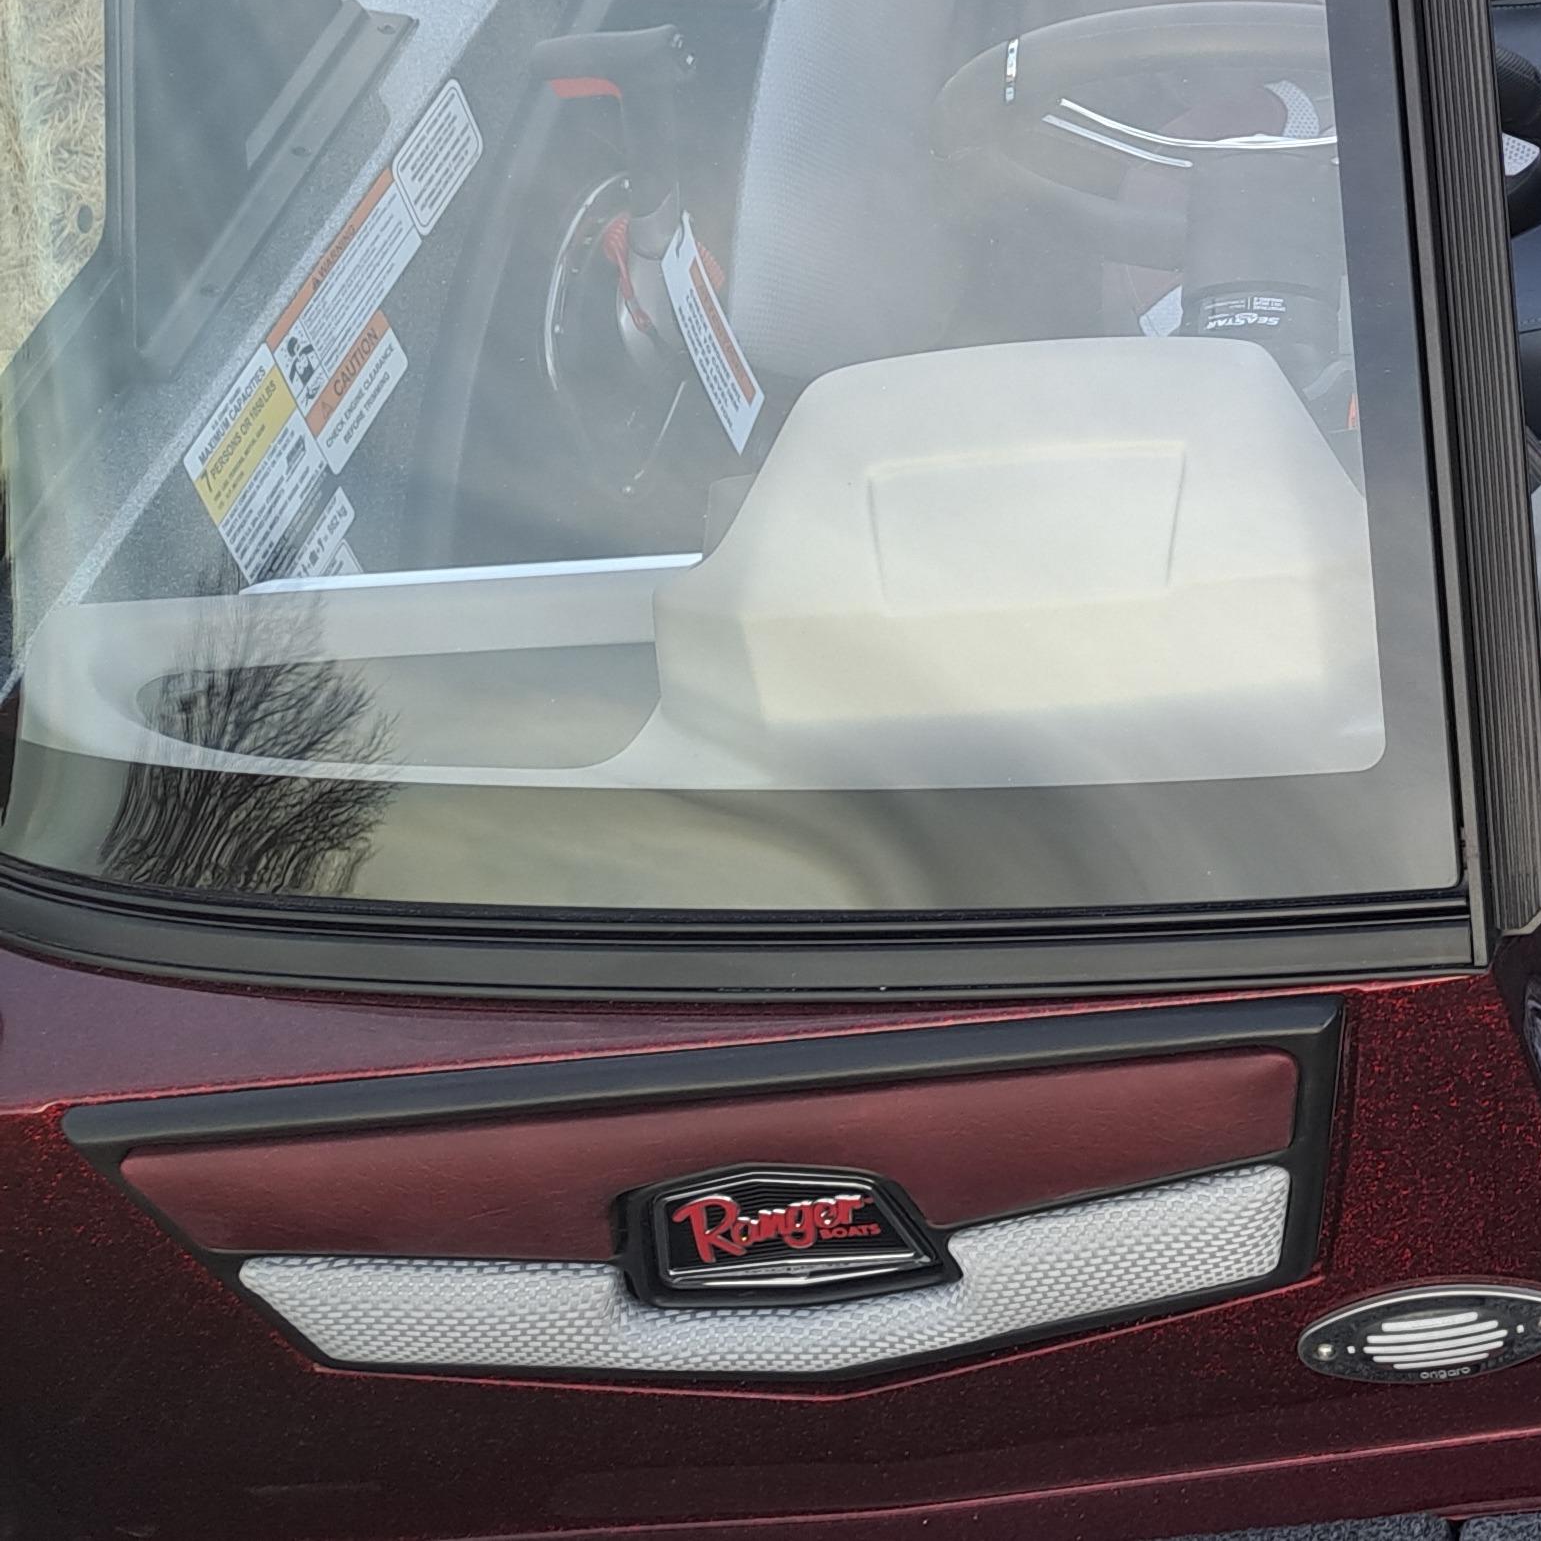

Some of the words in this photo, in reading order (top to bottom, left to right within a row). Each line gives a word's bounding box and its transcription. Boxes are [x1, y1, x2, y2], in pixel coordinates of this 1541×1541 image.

[316, 221, 356, 281] WARNING
[332, 326, 379, 398] CAUTION
[197, 416, 231, 466] MAXIMUM
[228, 363, 266, 422] CAPACITIES
[201, 466, 214, 495] 7
[209, 430, 242, 481] PERSONS
[239, 415, 252, 437] OR
[672, 1194, 863, 1264] Ranger
[818, 1223, 882, 1240] BOATS
[1420, 1366, 1471, 1379] ongaro
